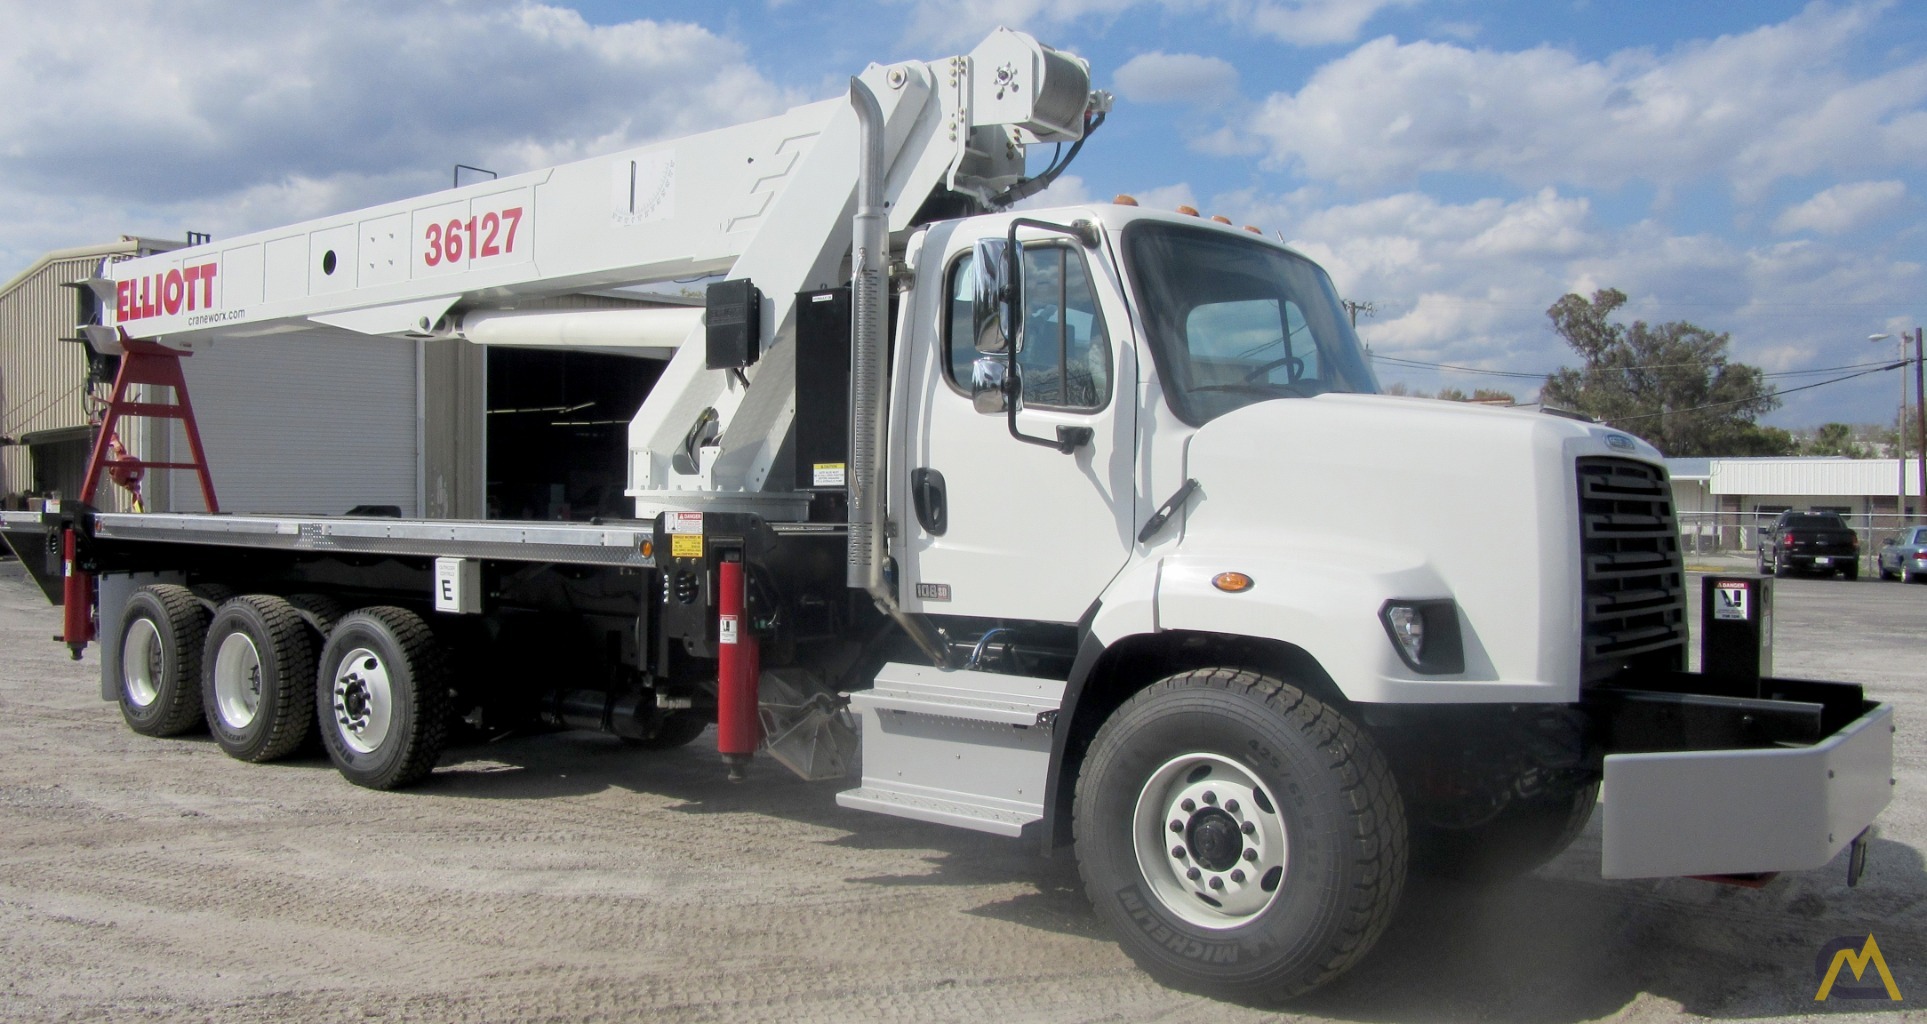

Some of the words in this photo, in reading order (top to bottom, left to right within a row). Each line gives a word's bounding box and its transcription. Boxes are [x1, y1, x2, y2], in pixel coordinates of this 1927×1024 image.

[424, 207, 523, 267] 36127
[116, 262, 217, 323] ELLIOTT
[188, 309, 245, 326] craneworx.com
[442, 580, 453, 601] E
[1118, 889, 1240, 963] MICHELIN
